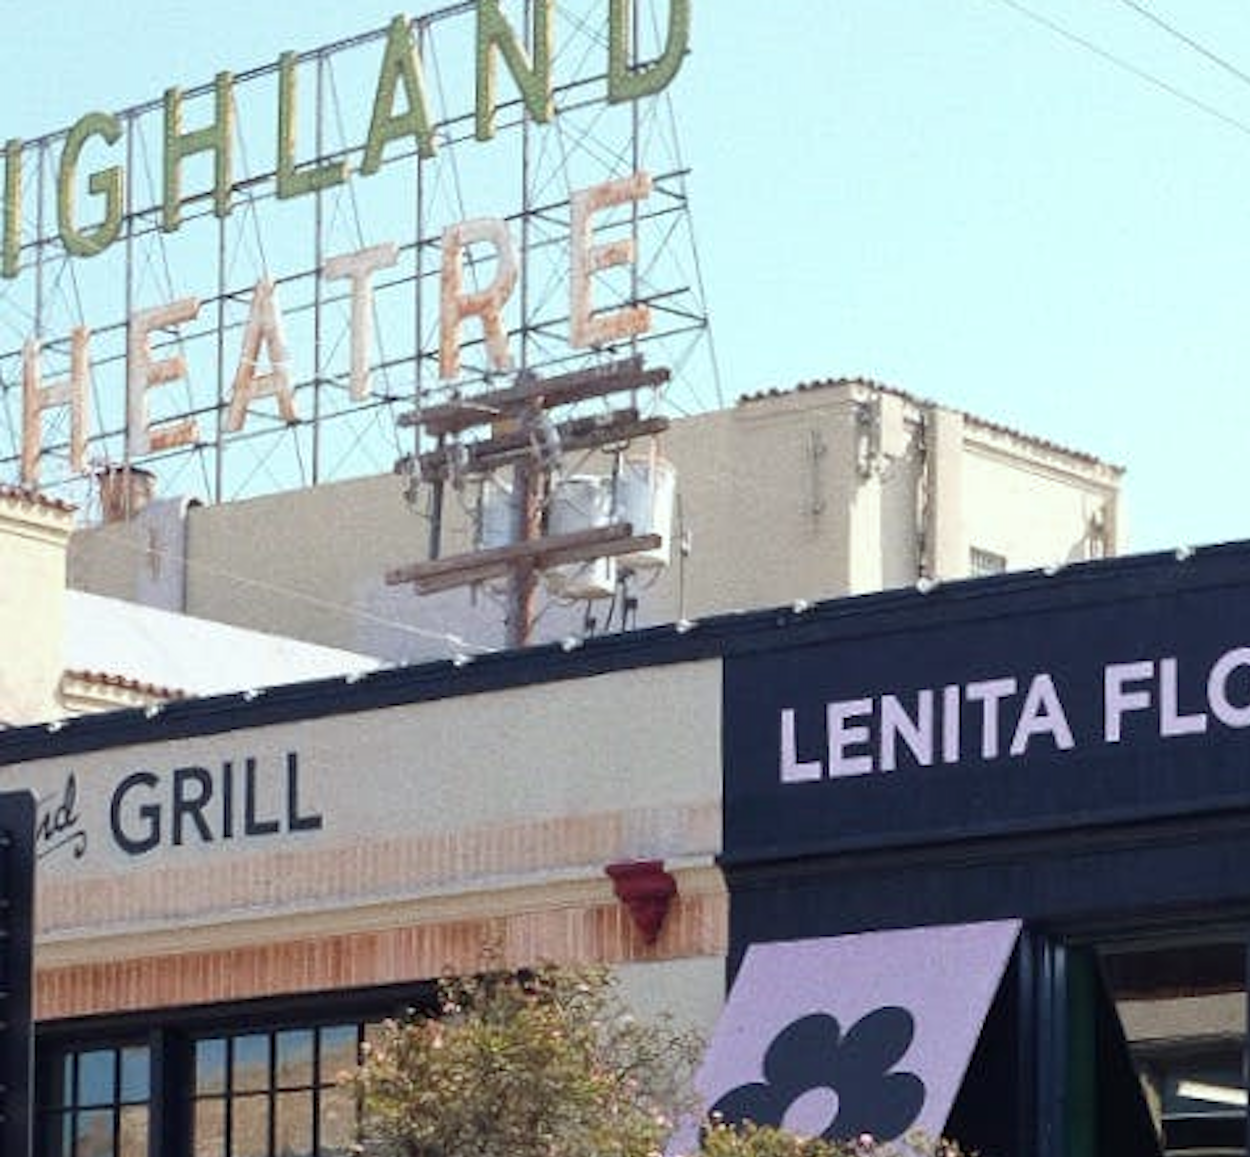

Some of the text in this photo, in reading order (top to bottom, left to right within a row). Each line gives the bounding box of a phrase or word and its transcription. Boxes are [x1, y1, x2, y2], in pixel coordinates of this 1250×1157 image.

[3, 0, 692, 278] IGHLAND
[20, 169, 655, 488] HEATRE
[109, 751, 324, 856] GRILL
[780, 672, 1076, 784] LENITA
